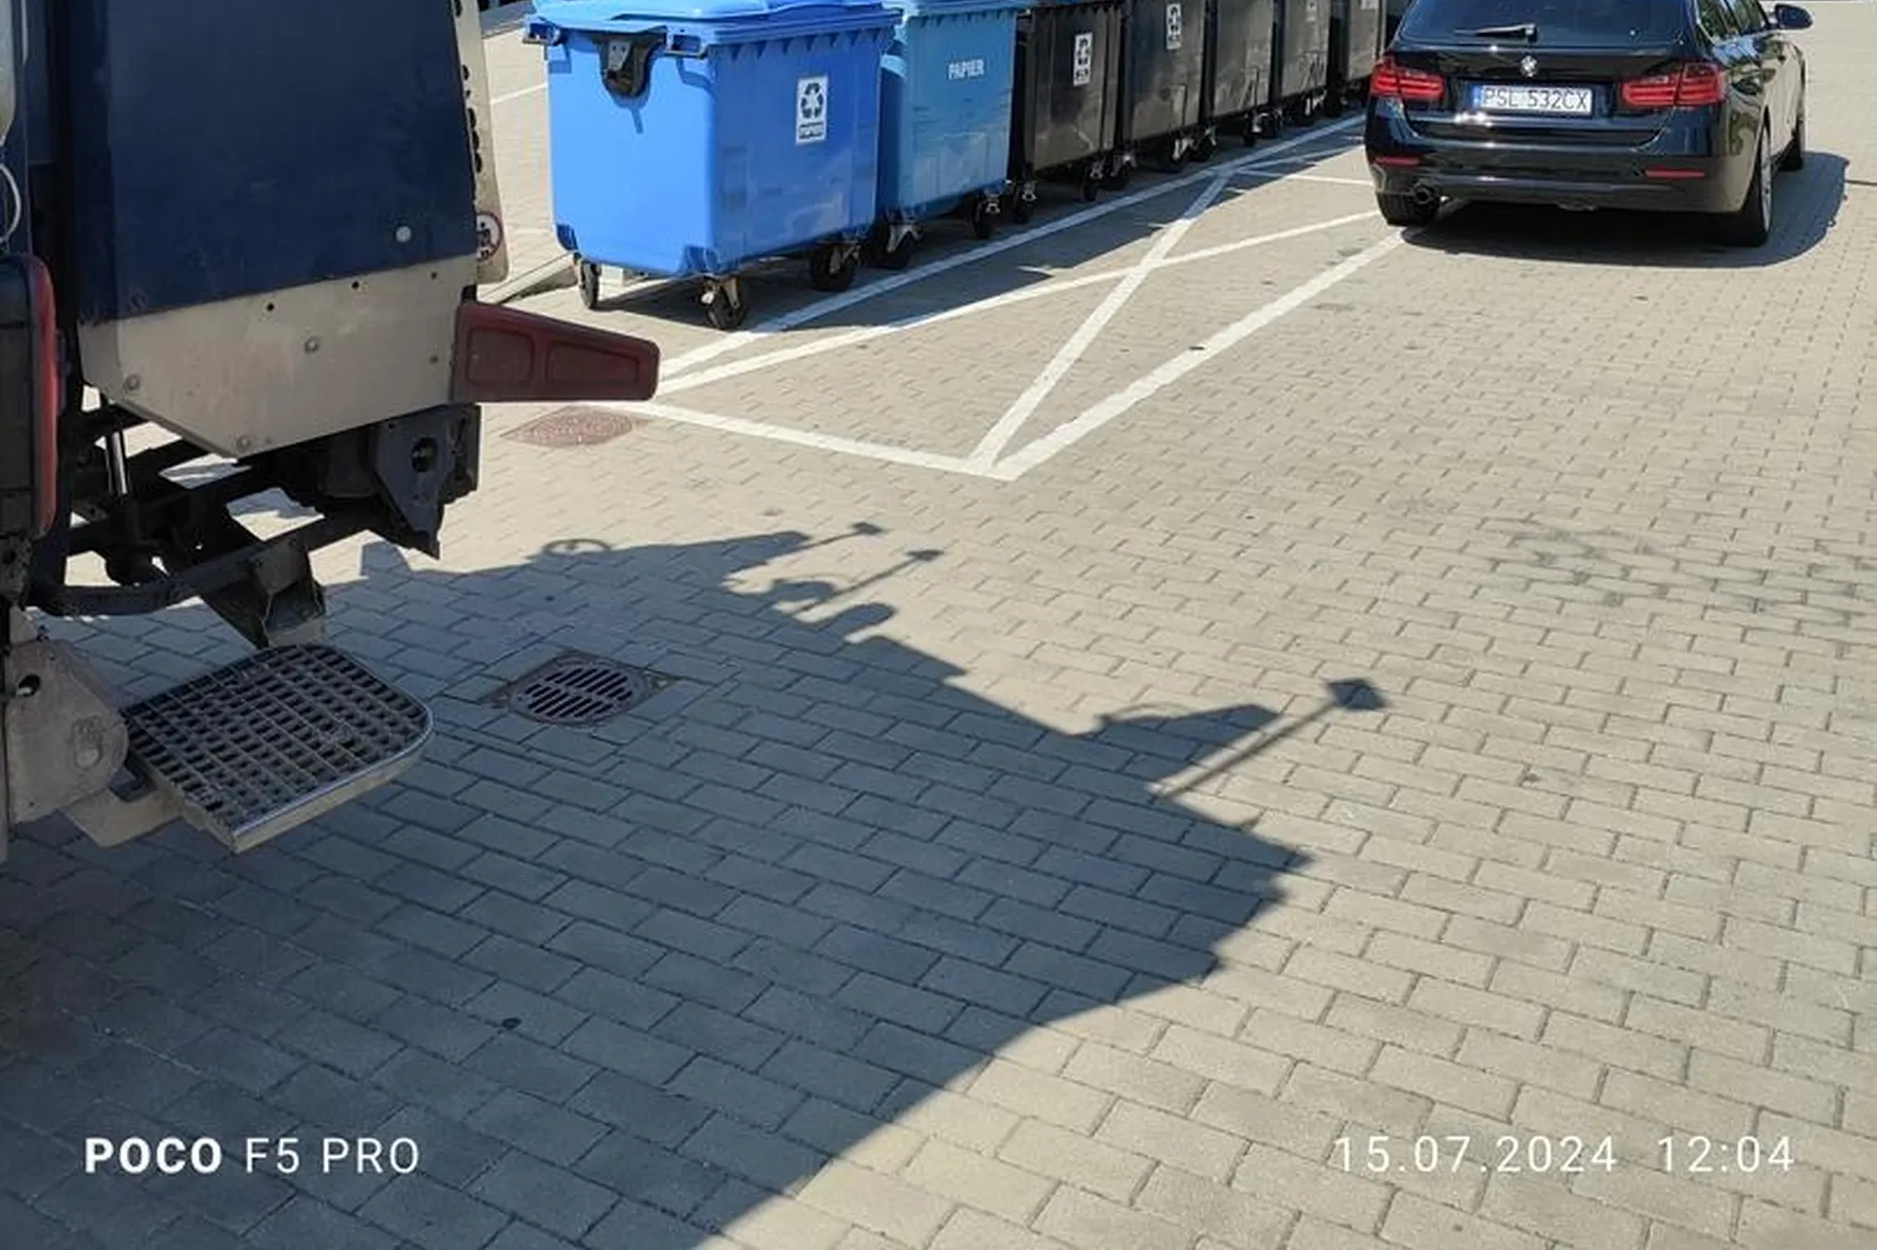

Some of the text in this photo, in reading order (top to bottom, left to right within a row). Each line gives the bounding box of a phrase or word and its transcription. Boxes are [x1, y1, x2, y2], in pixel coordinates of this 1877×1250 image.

[948, 59, 984, 80] PAPIER
[1483, 88, 1588, 110] PSL 532CX
